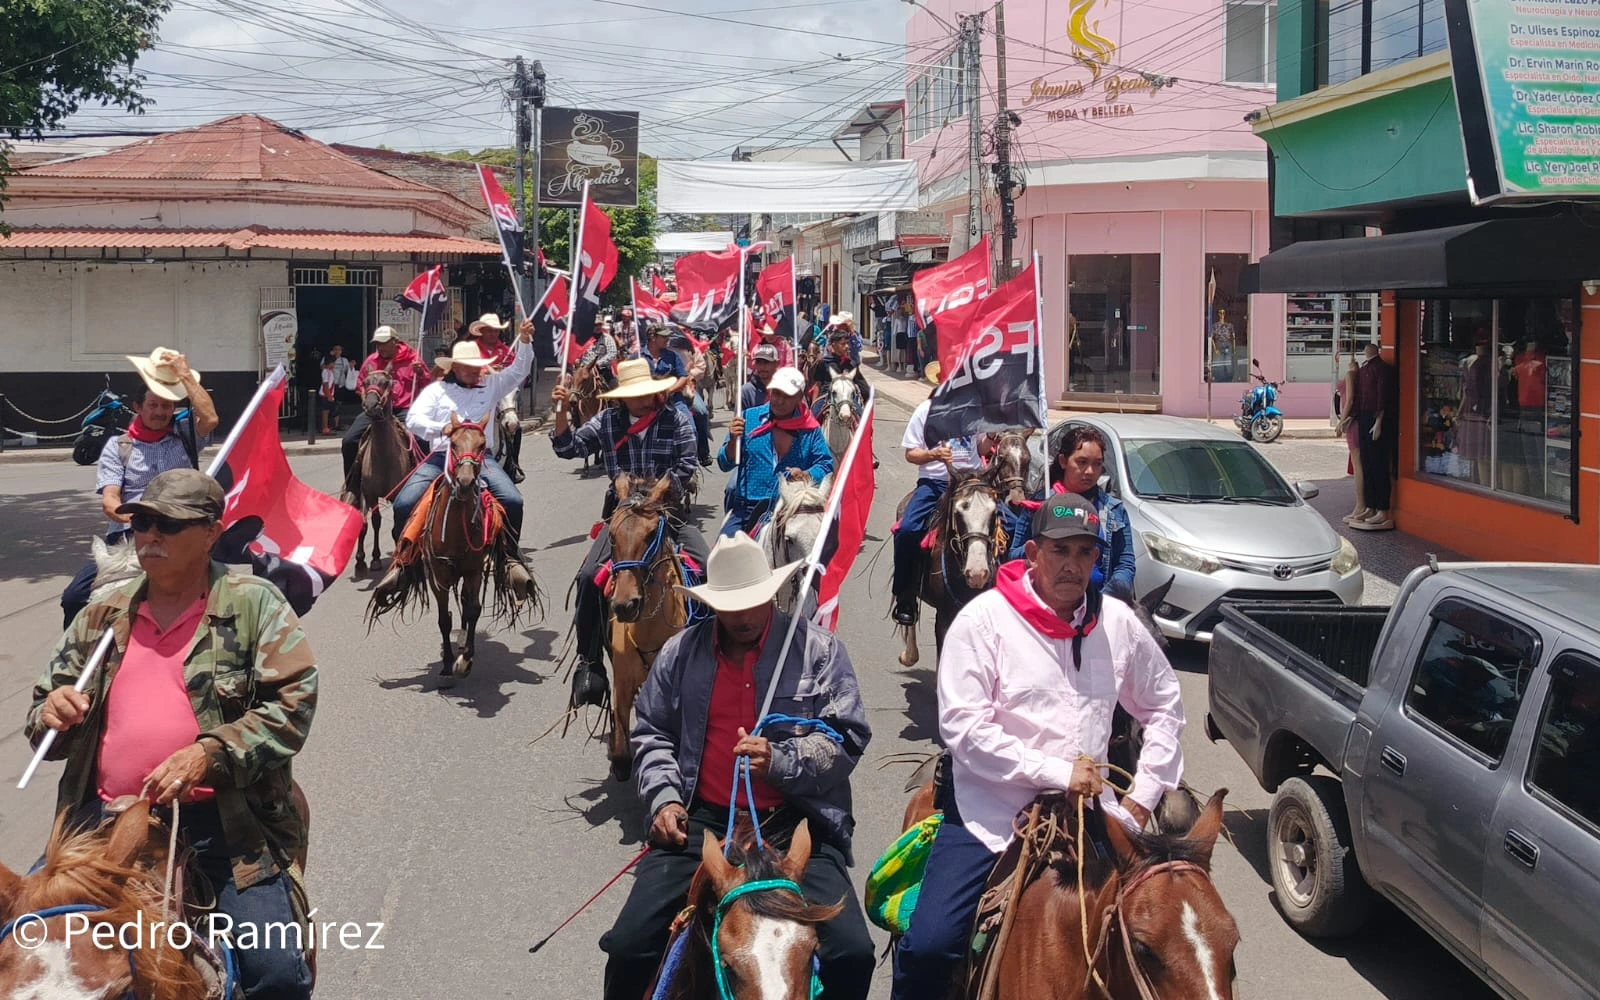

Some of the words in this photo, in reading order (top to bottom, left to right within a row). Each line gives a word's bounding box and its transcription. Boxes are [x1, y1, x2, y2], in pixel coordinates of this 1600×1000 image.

[1510, 23, 1526, 34] Dr.
[1528, 24, 1559, 36] Ulises
[1509, 57, 1525, 68] Dr.
[1527, 57, 1553, 69] Ervin
[1516, 91, 1533, 101] Dr.
[1533, 91, 1562, 102] Yader
[1047, 108, 1078, 119] MODA
[1082, 107, 1089, 118] Y
[1092, 104, 1134, 117] BELLEZA
[1538, 123, 1574, 134] Sharon
[1545, 161, 1568, 175] Yery
[1569, 162, 1590, 173] Joel
